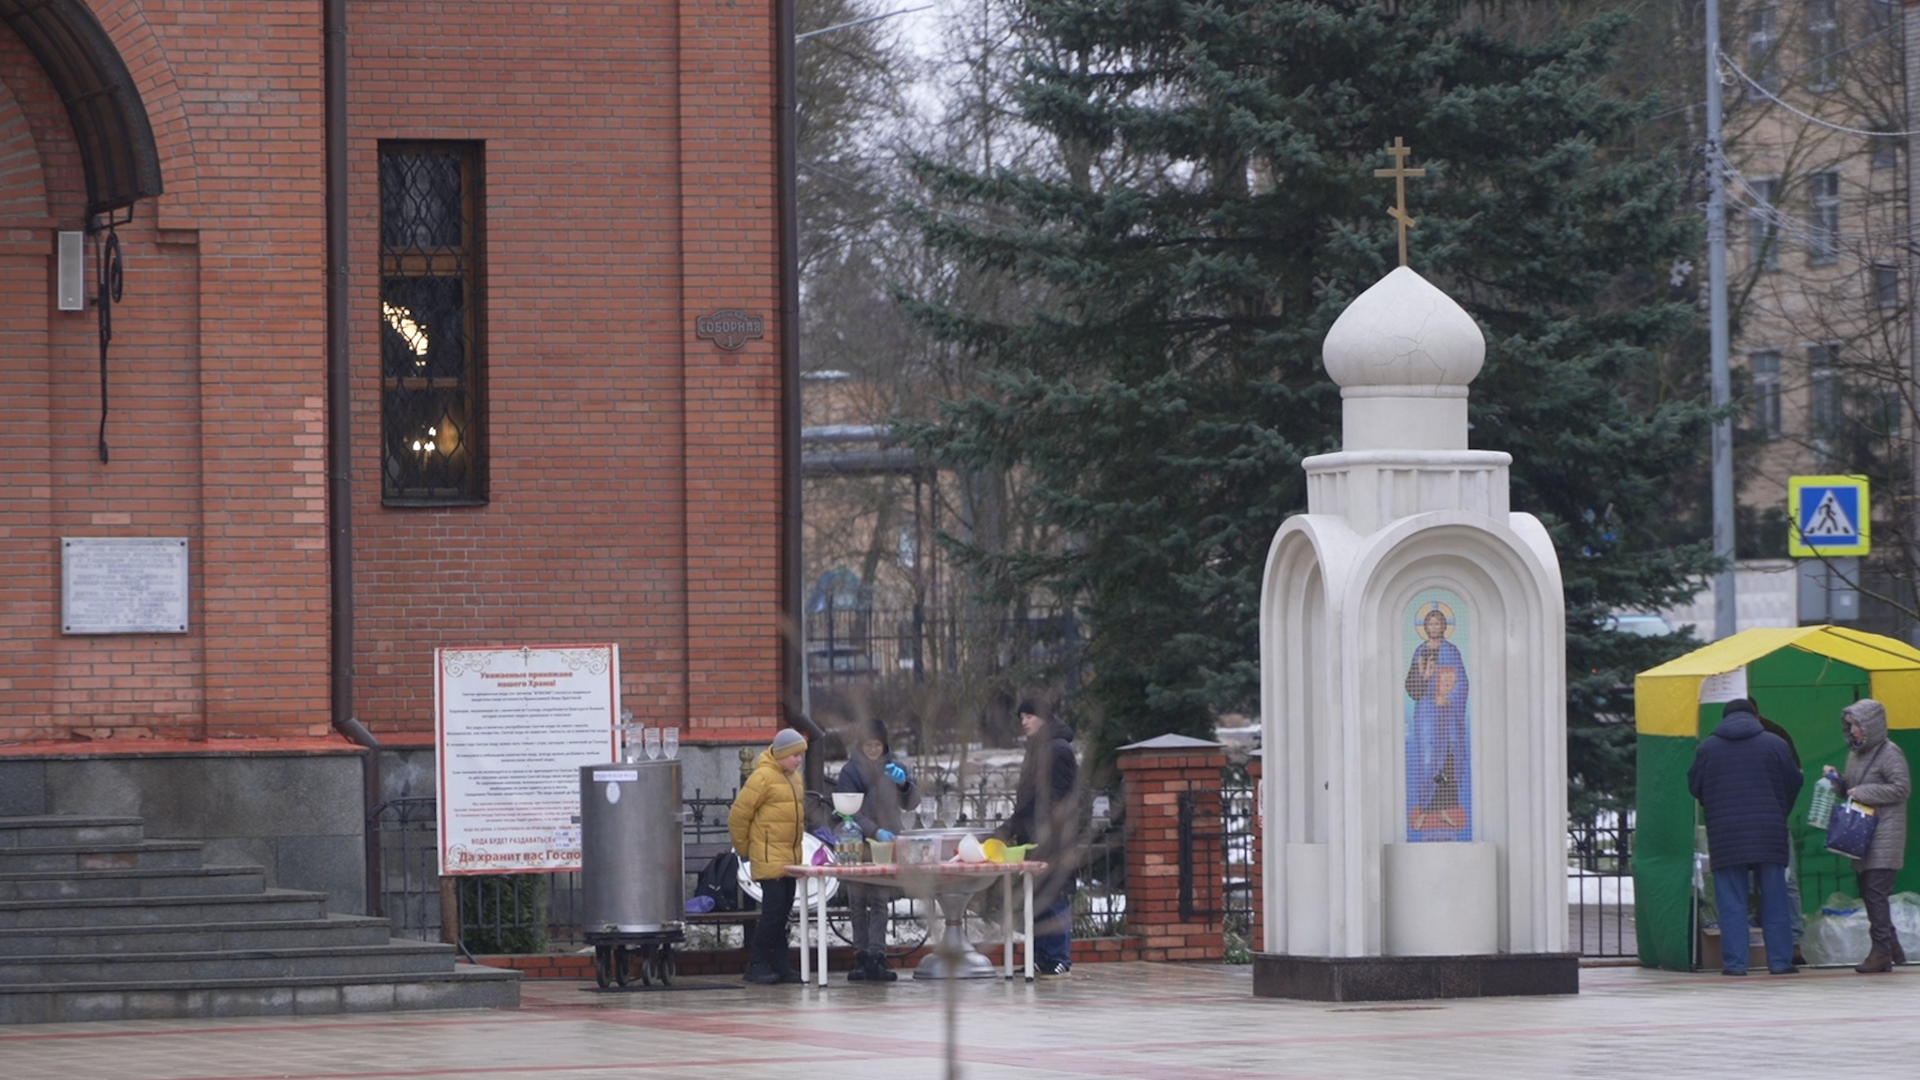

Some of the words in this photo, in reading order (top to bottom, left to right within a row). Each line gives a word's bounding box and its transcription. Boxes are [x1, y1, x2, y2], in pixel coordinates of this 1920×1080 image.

[700, 321, 760, 332] СОБОРНАЯ
[728, 336, 733, 347] 1
[480, 671, 527, 679] Уважаемые
[528, 671, 573, 680] прихожане
[528, 680, 556, 688] Храма!
[459, 852, 475, 863] Да
[477, 853, 521, 864] хранит
[523, 852, 544, 861] вас
